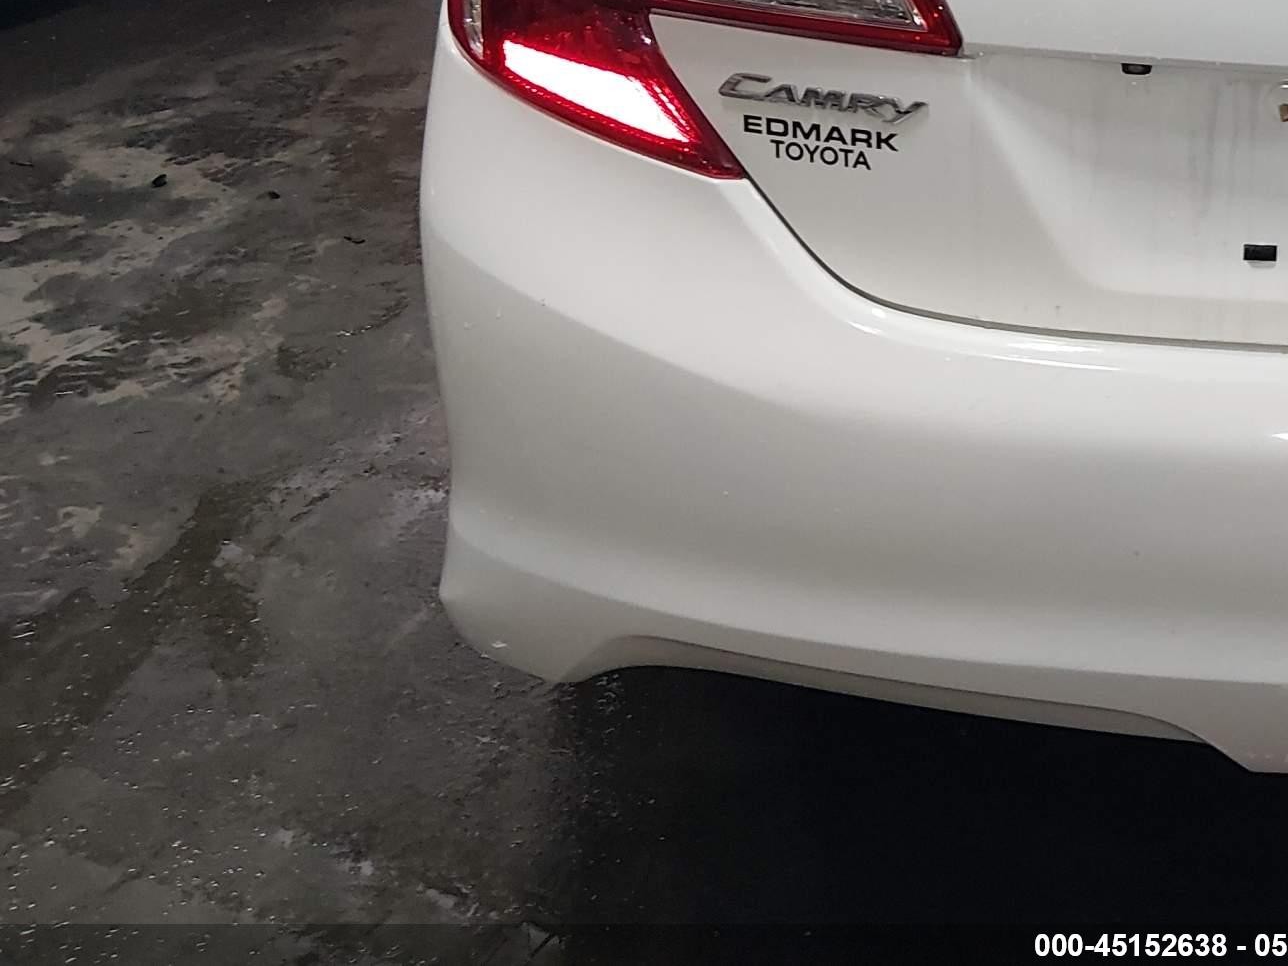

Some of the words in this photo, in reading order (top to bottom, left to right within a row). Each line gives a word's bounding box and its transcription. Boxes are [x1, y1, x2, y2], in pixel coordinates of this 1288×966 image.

[718, 72, 929, 124] CAMRY
[743, 114, 899, 152] EDMARK
[770, 139, 872, 171] TOYOTA
